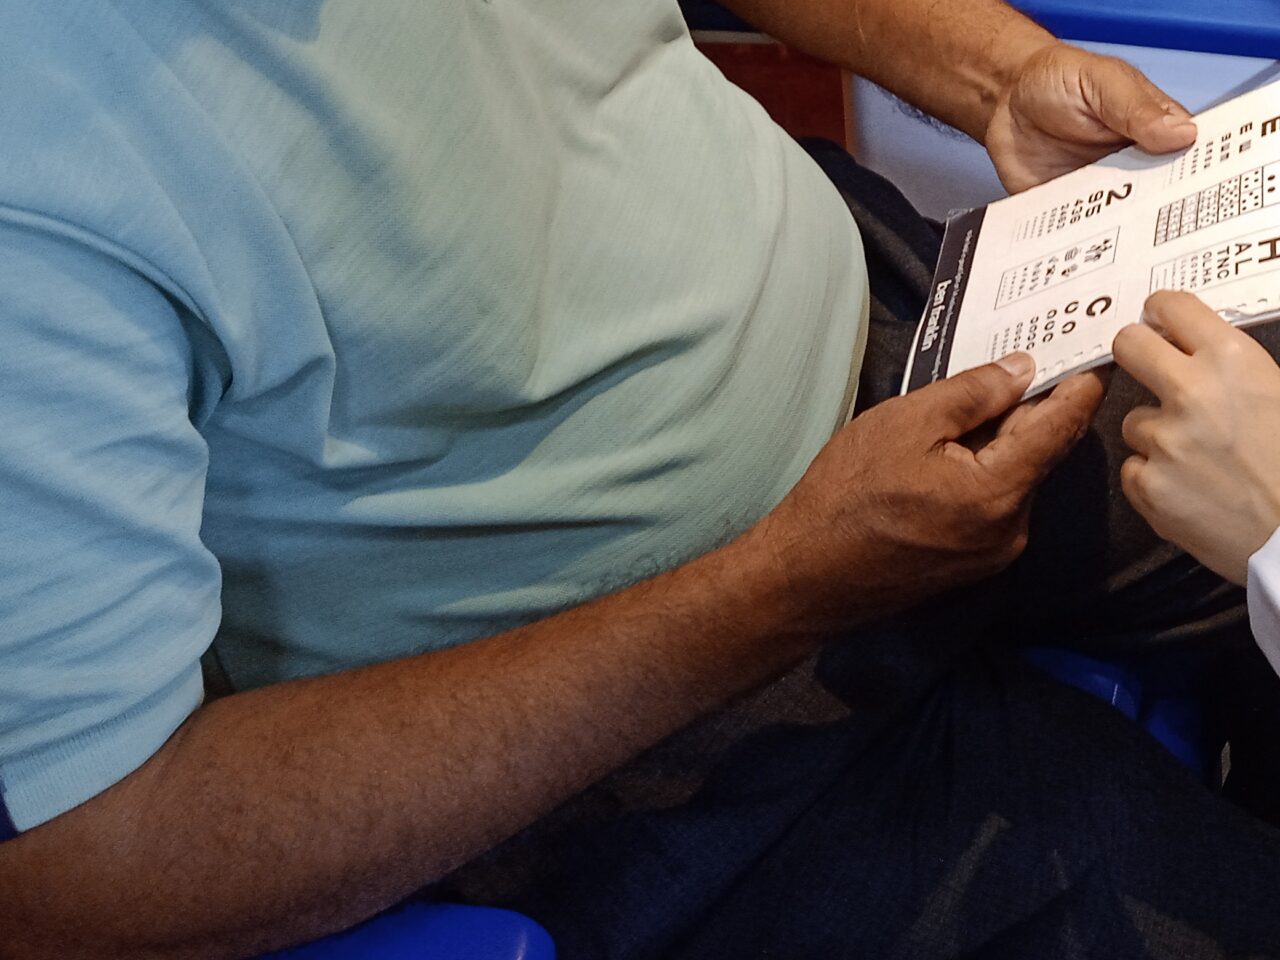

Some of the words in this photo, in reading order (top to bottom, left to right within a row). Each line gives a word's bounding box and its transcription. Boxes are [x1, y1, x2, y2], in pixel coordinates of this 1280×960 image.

[1085, 190, 1104, 218] 95
[1105, 182, 1133, 207] 2
[933, 279, 952, 306] ben
[921, 305, 945, 352] franklin
